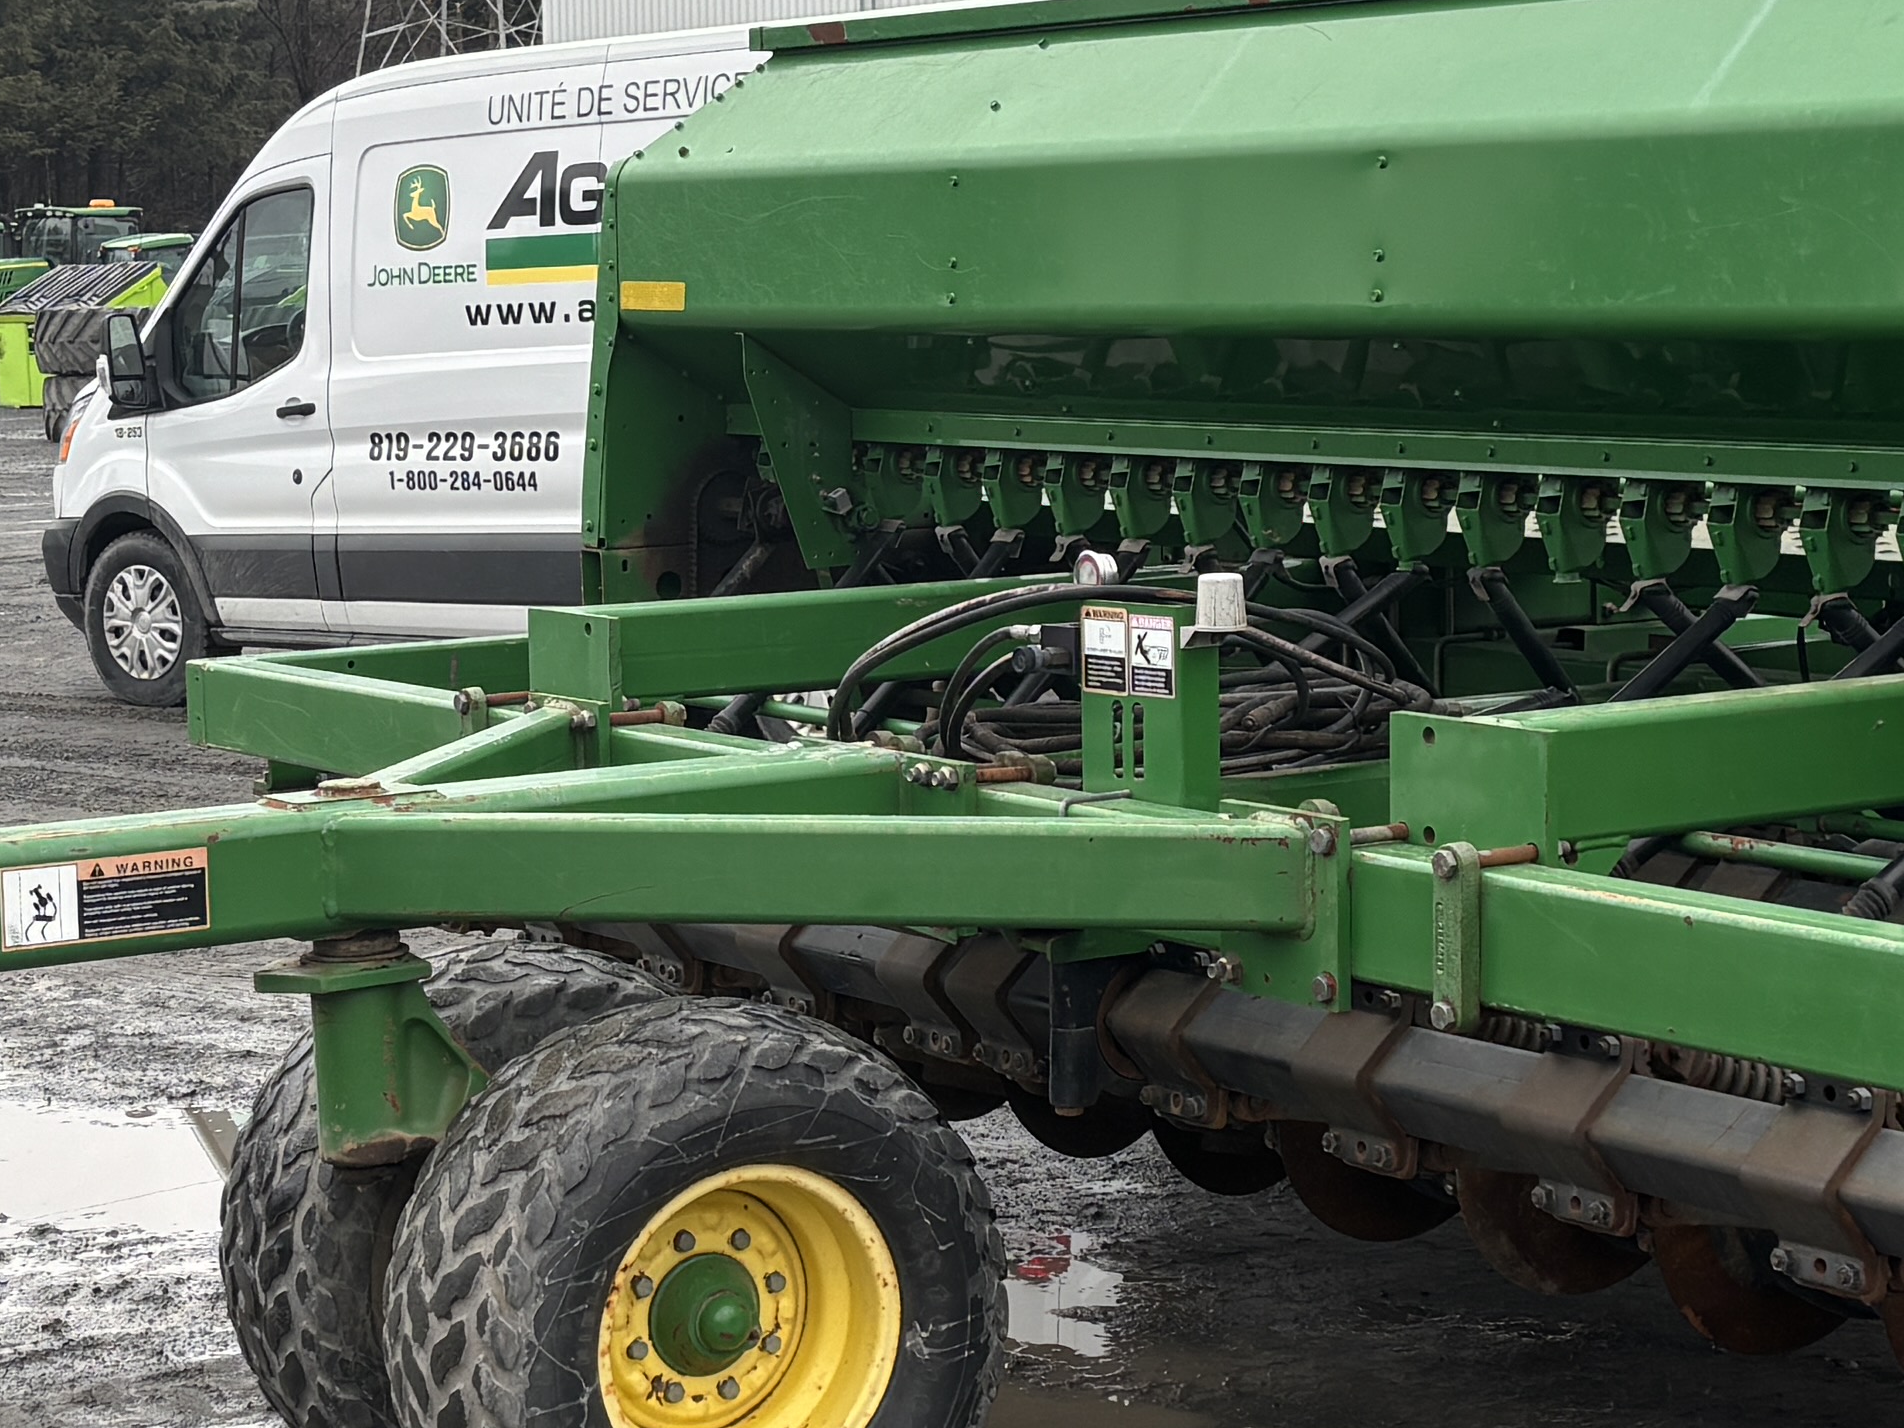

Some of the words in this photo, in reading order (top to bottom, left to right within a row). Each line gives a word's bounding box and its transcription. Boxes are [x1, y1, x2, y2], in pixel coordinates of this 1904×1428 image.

[487, 82, 567, 125] UNITÉ
[577, 84, 614, 118] DE
[367, 264, 415, 287] JOHN
[418, 262, 478, 285] DEERE
[369, 431, 561, 462] 819-229-3686
[388, 469, 538, 492] 1-800-284-0644
[115, 856, 195, 875] WARNING
